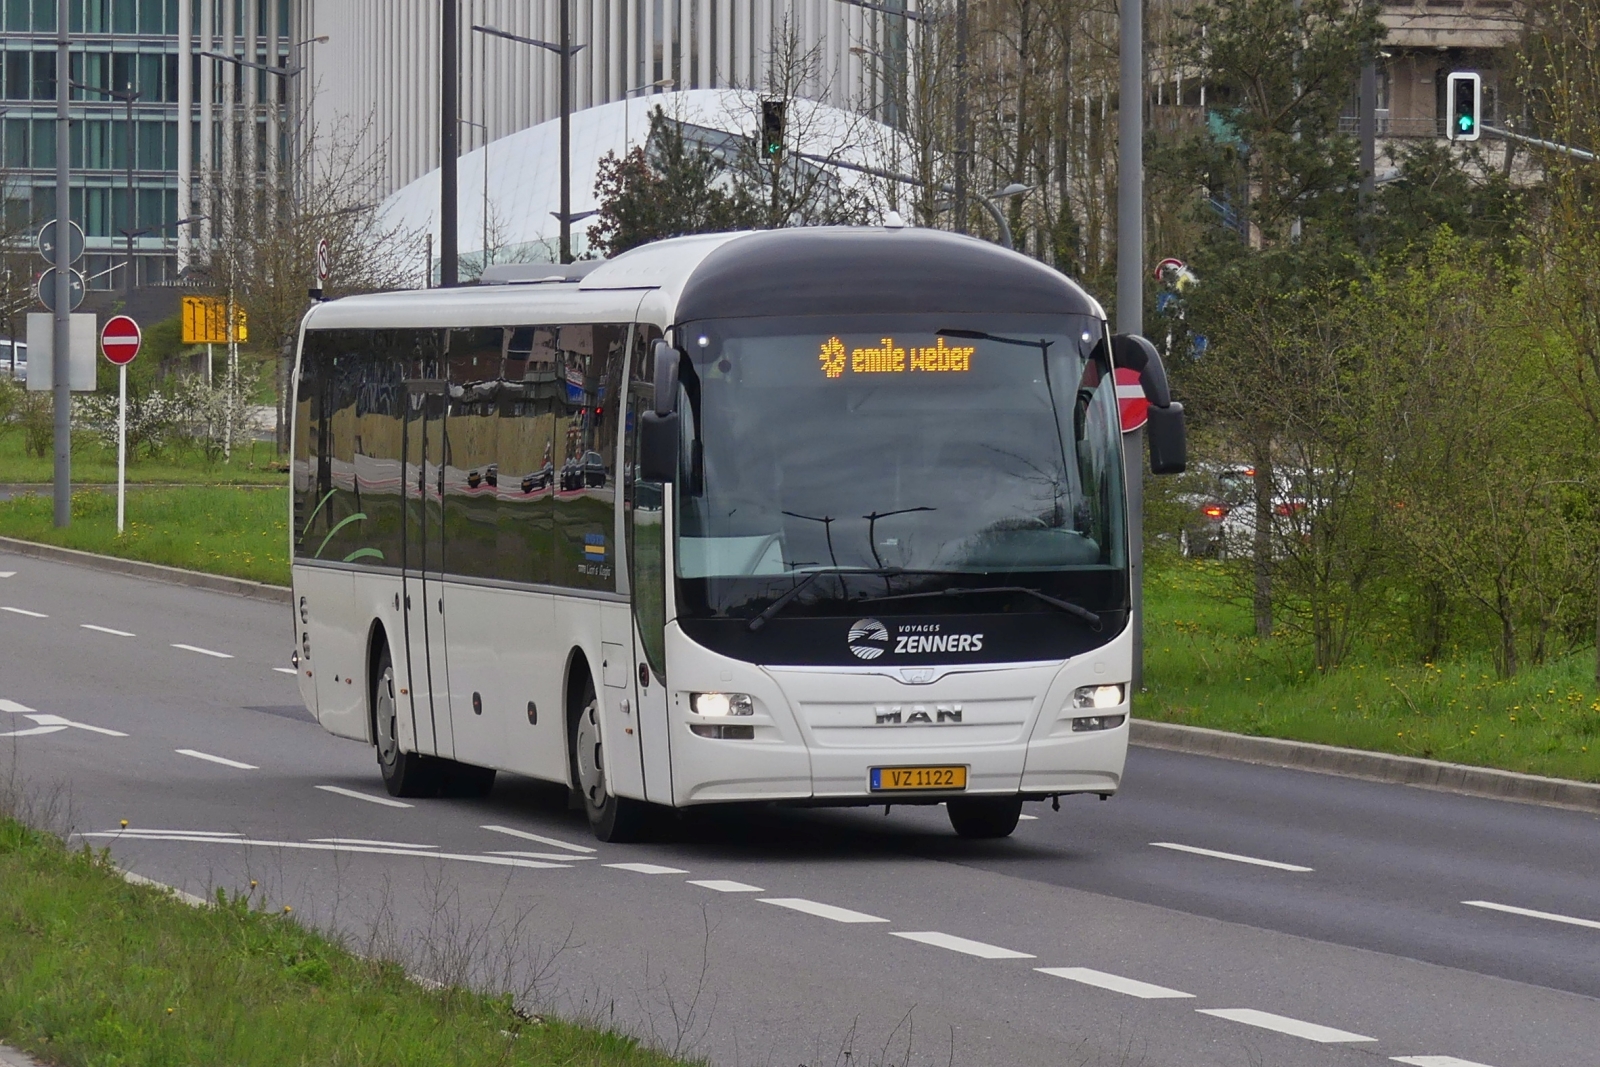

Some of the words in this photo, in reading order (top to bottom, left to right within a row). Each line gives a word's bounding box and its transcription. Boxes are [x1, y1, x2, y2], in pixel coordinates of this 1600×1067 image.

[852, 338, 905, 372] emile
[910, 337, 975, 371] weber
[899, 624, 941, 632] VOYAGES
[894, 634, 984, 653] ZENNERS
[875, 705, 962, 724] MAN
